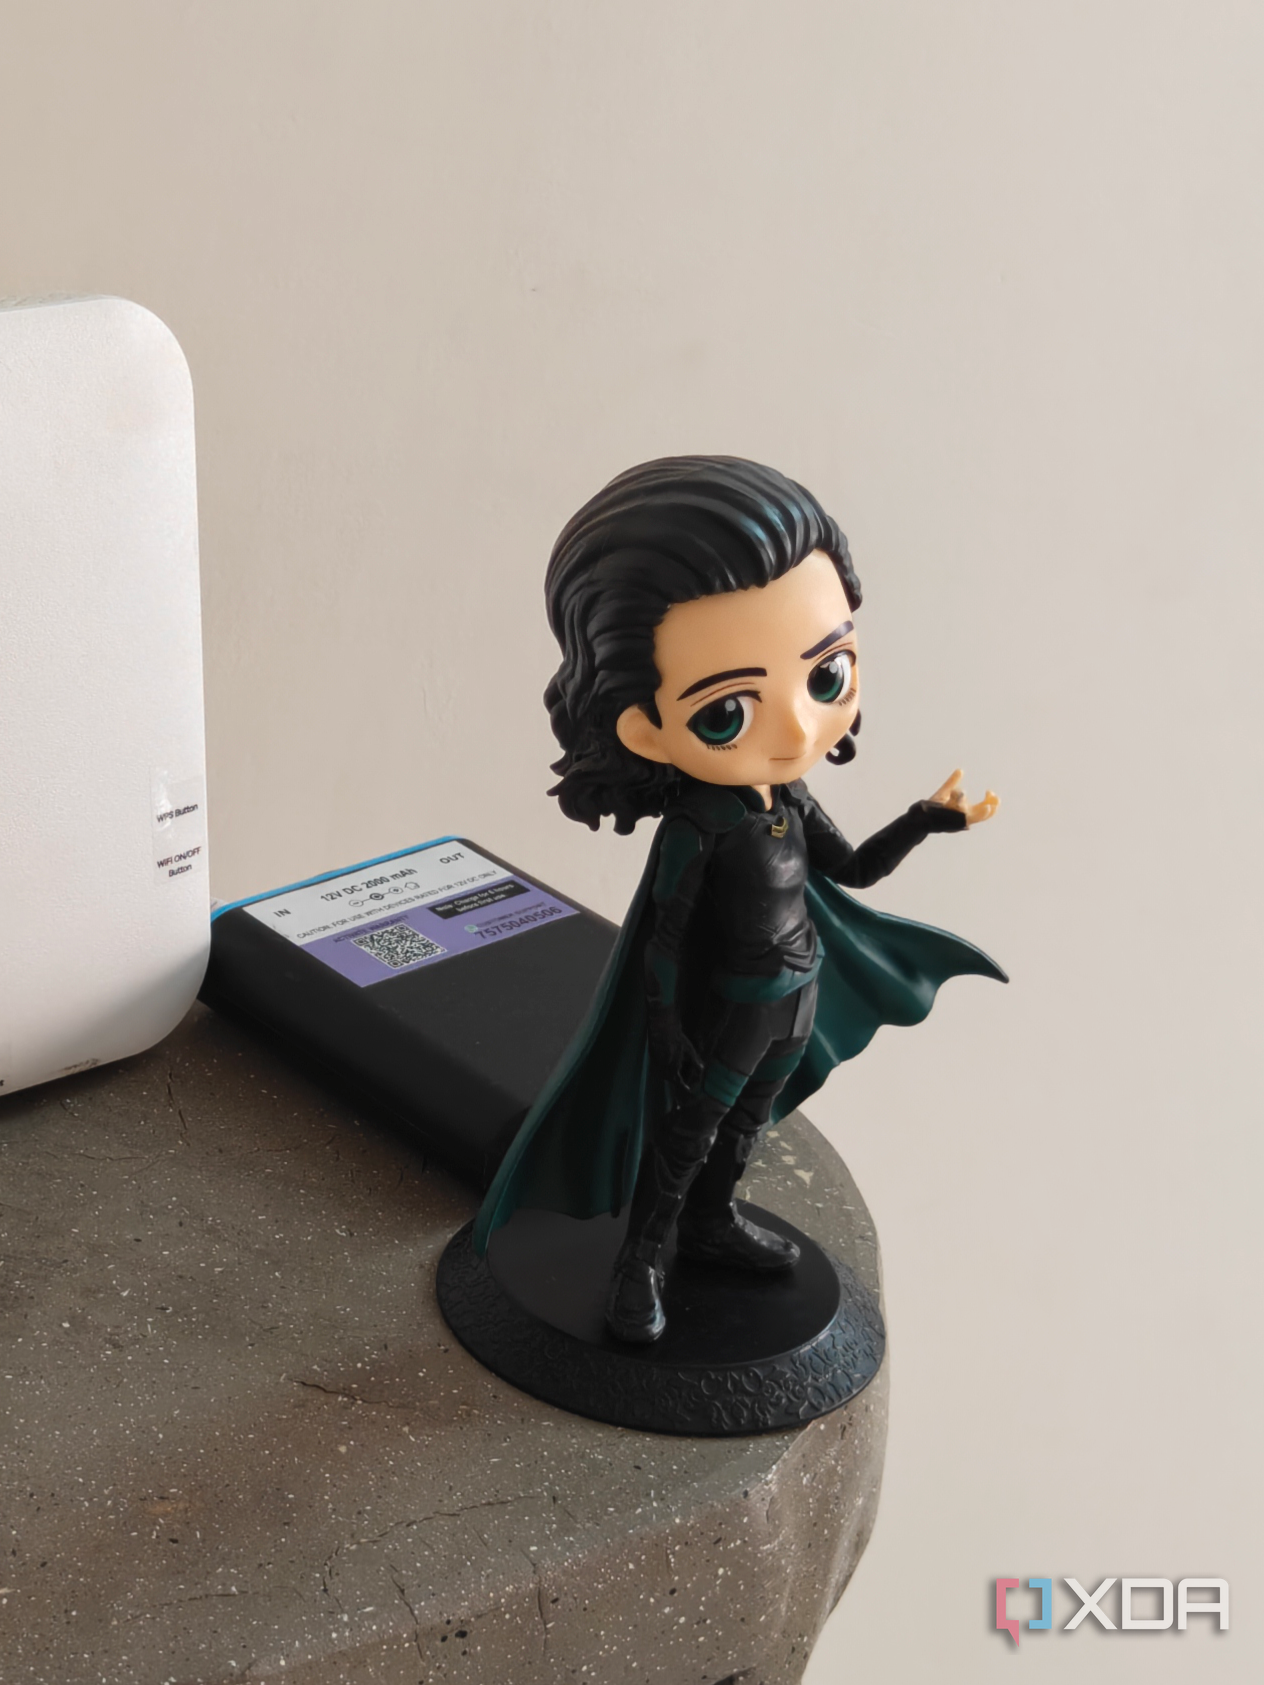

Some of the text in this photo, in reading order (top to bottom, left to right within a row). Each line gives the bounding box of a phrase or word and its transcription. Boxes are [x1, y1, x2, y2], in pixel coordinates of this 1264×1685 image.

[157, 804, 198, 823] WPS Button
[174, 846, 202, 862] ON/OFF
[439, 852, 465, 864] OUT
[168, 864, 192, 877] Button
[320, 868, 418, 901] 12V DC 2000 mAh
[332, 919, 348, 927] FOR
[365, 907, 383, 916] WITH
[384, 898, 415, 909] DEVICES
[415, 890, 439, 899] RATED
[439, 884, 455, 892] FOR
[478, 870, 497, 879] ONLY
[476, 891, 489, 899] for
[273, 909, 291, 917] IN
[474, 906, 562, 939] 7575040506
